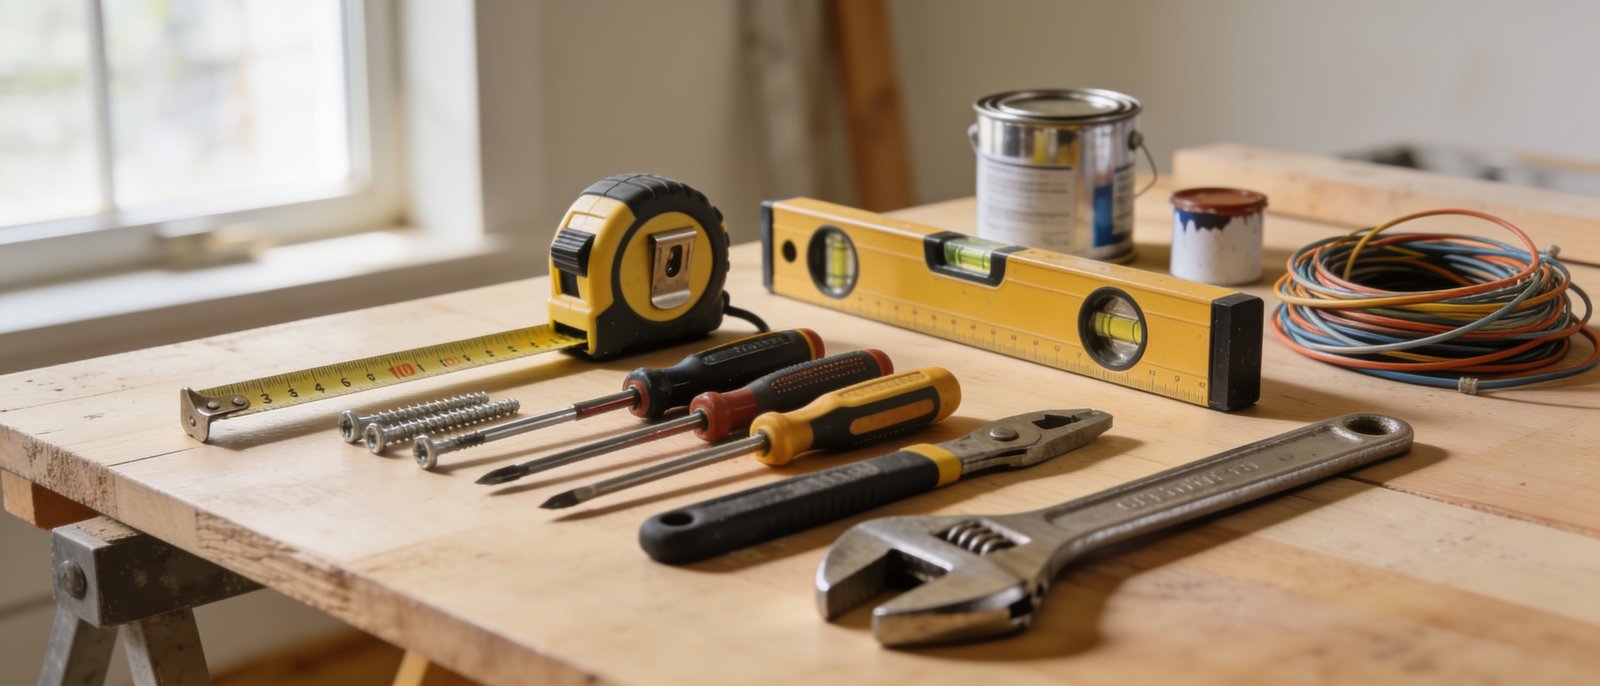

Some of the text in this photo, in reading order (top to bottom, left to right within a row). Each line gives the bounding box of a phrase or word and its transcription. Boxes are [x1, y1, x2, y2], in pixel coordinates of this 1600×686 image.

[260, 393, 273, 404] 3
[315, 383, 326, 393] 4
[341, 378, 352, 388] 6
[388, 363, 417, 380] 10
